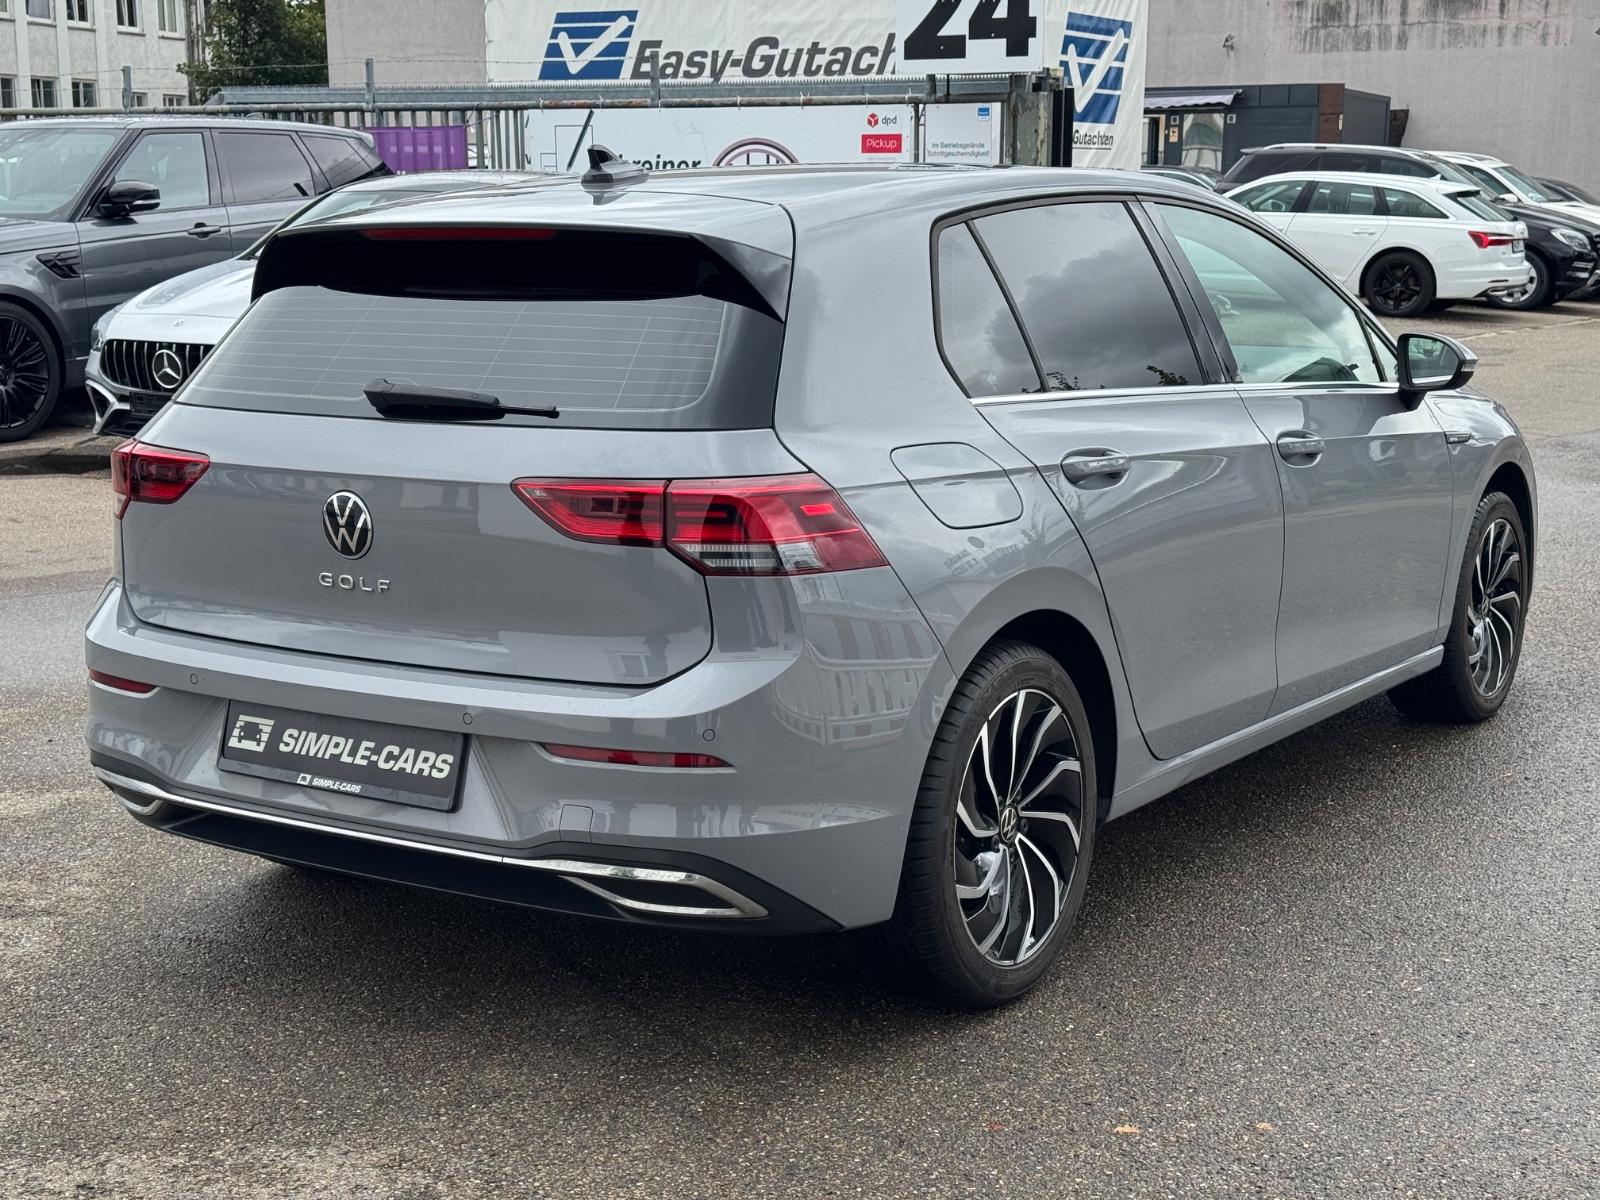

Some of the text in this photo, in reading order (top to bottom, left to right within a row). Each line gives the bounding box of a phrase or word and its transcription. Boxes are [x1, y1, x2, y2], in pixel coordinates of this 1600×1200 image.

[881, 115, 897, 126] dpd
[866, 138, 898, 149] Pickup
[318, 571, 390, 593] GOLF
[278, 728, 454, 779] SIMPLE-CARS
[311, 777, 362, 794] SIMPLE-CARS
